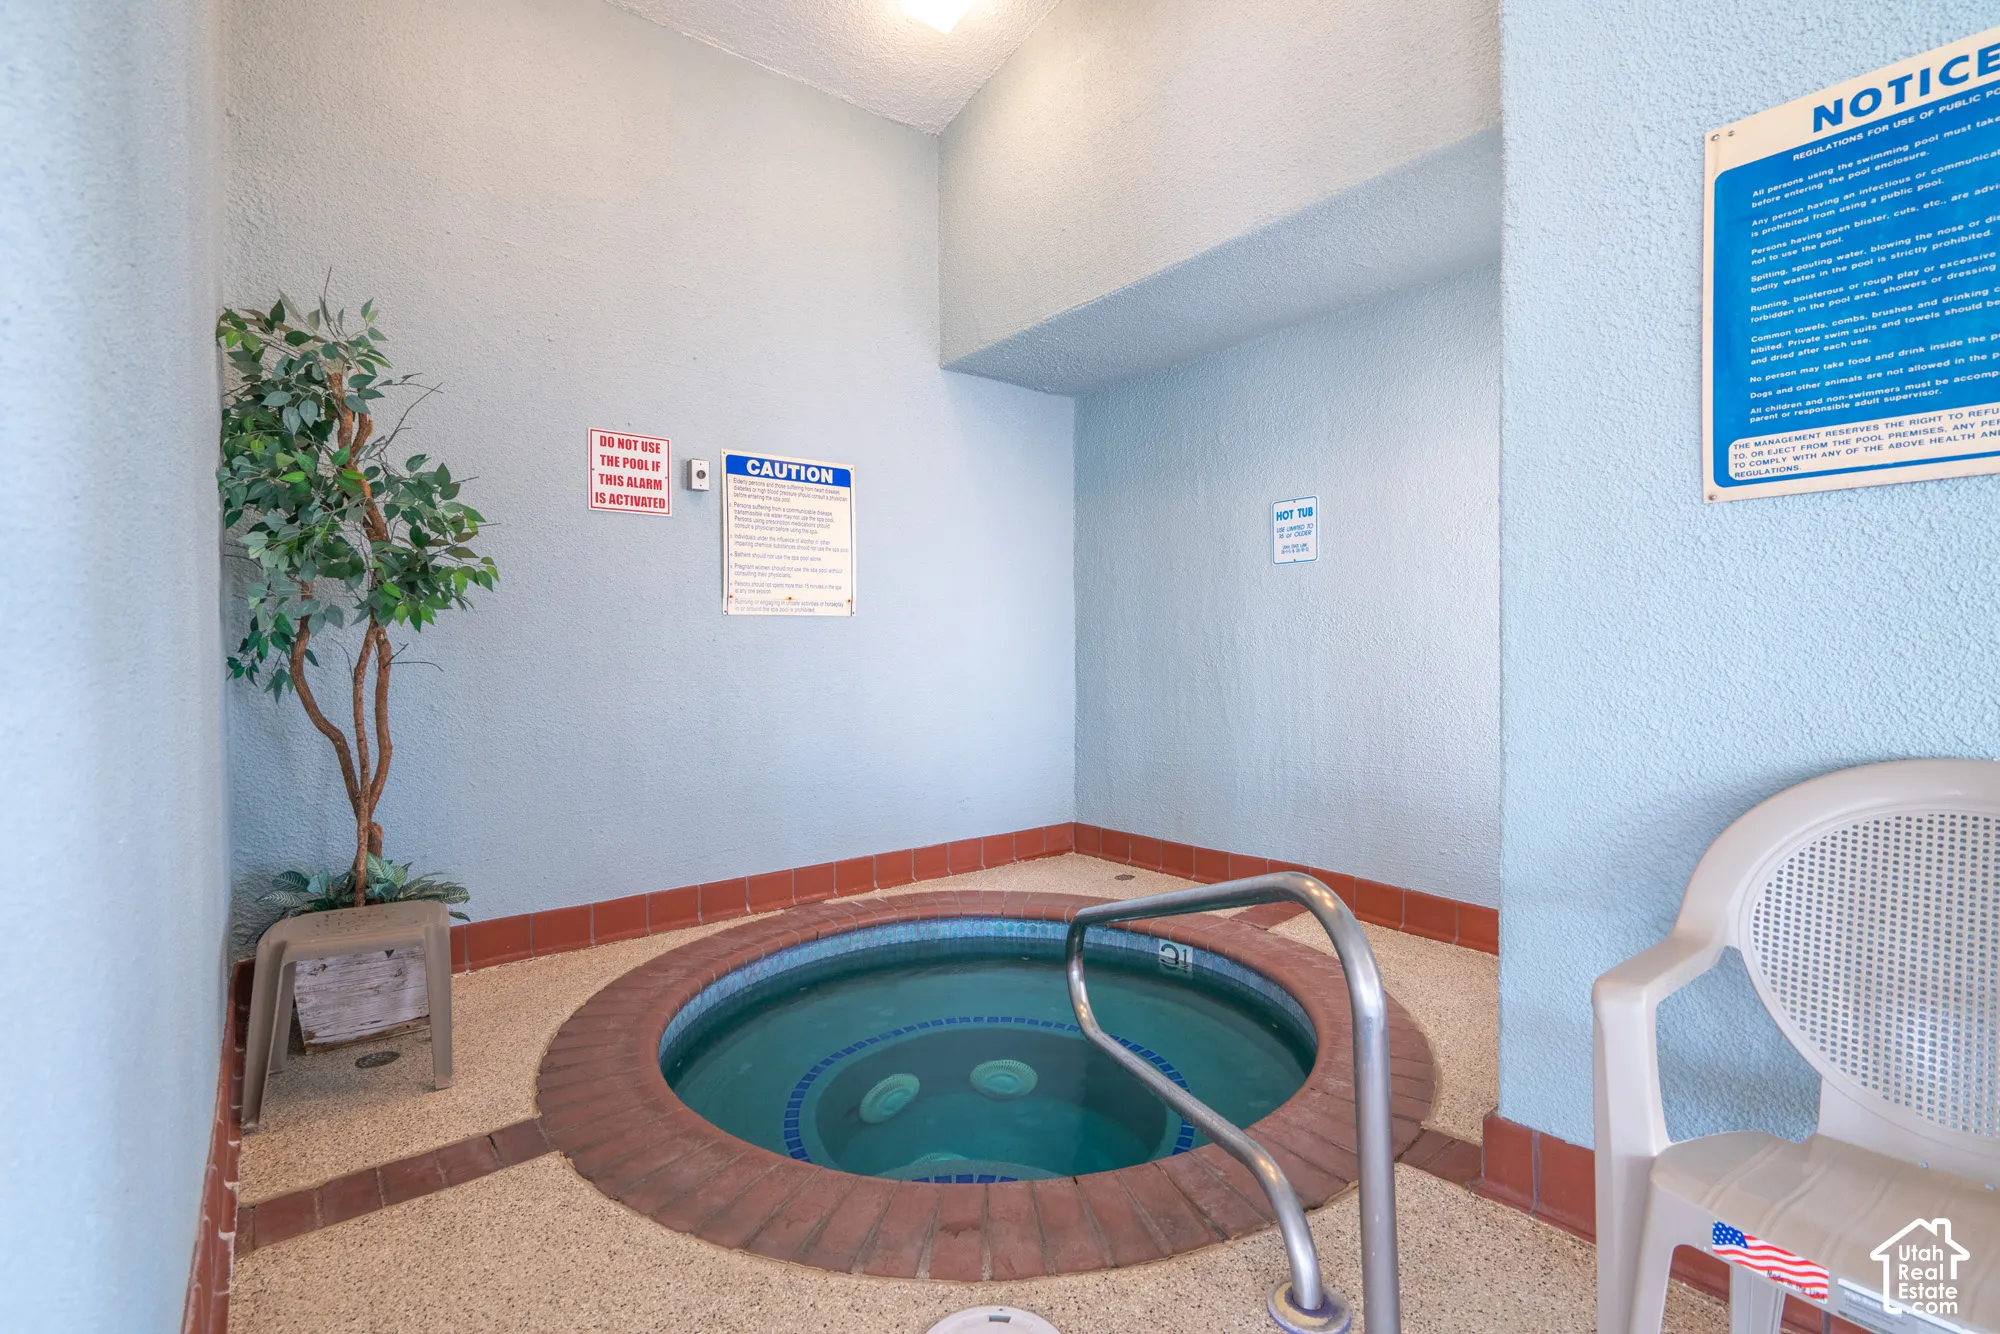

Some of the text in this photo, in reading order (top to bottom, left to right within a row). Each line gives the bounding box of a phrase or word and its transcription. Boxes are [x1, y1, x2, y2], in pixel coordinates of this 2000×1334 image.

[1813, 42, 2000, 134] NOTICE
[1792, 93, 1980, 161] REGULATIONS FOR USE OF PUBLIC
[1751, 150, 1930, 208] before entering pool enclosure.
[1752, 188, 1764, 197] All
[1767, 177, 1803, 193] persons
[1807, 167, 1833, 180] using
[1837, 161, 1853, 170] the
[1856, 144, 1909, 164] swimming
[1913, 133, 1938, 148] pool
[1943, 123, 1971, 137] must
[1751, 217, 1768, 226] Any
[1771, 207, 1803, 221] person
[1807, 196, 1839, 210] having
[1858, 176, 1911, 195] infectious
[1761, 178, 1944, 235] prohibited from using public pool.
[1750, 229, 1993, 293] bodily strictly prohibited.
[1751, 232, 1822, 255] Persons having
[1751, 236, 1844, 265] not use pool.
[1791, 237, 1911, 272] spouting blowing
[1750, 264, 1996, 322] forbidden showers dressing
[1793, 251, 1996, 302] boisterous rough play excessive
[1750, 288, 1989, 342] Common brushes and drinking
[1750, 342, 1784, 354] hibited.
[1787, 335, 1820, 346] Private
[1824, 330, 1849, 339] swim
[1852, 324, 1877, 334] suits
[1880, 318, 1900, 328] and
[1904, 311, 1940, 323] towels
[1944, 301, 1982, 315] should
[1750, 337, 1872, 365] and dried after each use.
[1764, 370, 1796, 381] person
[1799, 366, 1819, 374] may
[1822, 361, 1844, 369] take
[1847, 355, 1871, 365] food
[1874, 351, 1894, 360] and
[1897, 346, 1924, 356] drink
[1929, 339, 1963, 350] inside
[1749, 359, 1950, 398] Dogs and other animals are not allowed
[1764, 401, 1802, 412] children
[1805, 397, 1822, 406] and
[1826, 386, 1900, 402] non-swimmers
[1904, 380, 1930, 390] must
[1952, 370, 2000, 382] accomp
[1749, 388, 1941, 423] parent responsible adult supervisor.
[600, 436, 660, 454] DO NOT USE
[1732, 442, 1750, 450] THE
[1753, 431, 1820, 447] MANAGEMENT
[1824, 423, 1879, 437] RESERVES
[1884, 420, 1904, 428] THE
[1908, 414, 1942, 425] RIGHT
[1947, 412, 1964, 420] TO
[1748, 456, 1786, 467] COMPLY
[1792, 452, 1817, 461] WITH
[1820, 449, 1841, 457] ANY
[1863, 444, 1882, 452] THE
[1887, 438, 1924, 449] ABOVE
[1928, 432, 1975, 444] HEALTH
[1766, 445, 1796, 455] EJECT
[1800, 441, 1828, 450] FROM
[1832, 438, 1851, 446] THE
[1855, 434, 1883, 443] POOL
[1952, 422, 1975, 431] ANY
[598, 473, 662, 491] THIS ALARM
[600, 454, 661, 472] THE POOL IF
[746, 460, 833, 484] CAUTION
[1734, 464, 1801, 479] REGULATIONS.
[595, 492, 665, 508] IS ACTIVATED
[1276, 507, 1313, 521] HOT TUB
